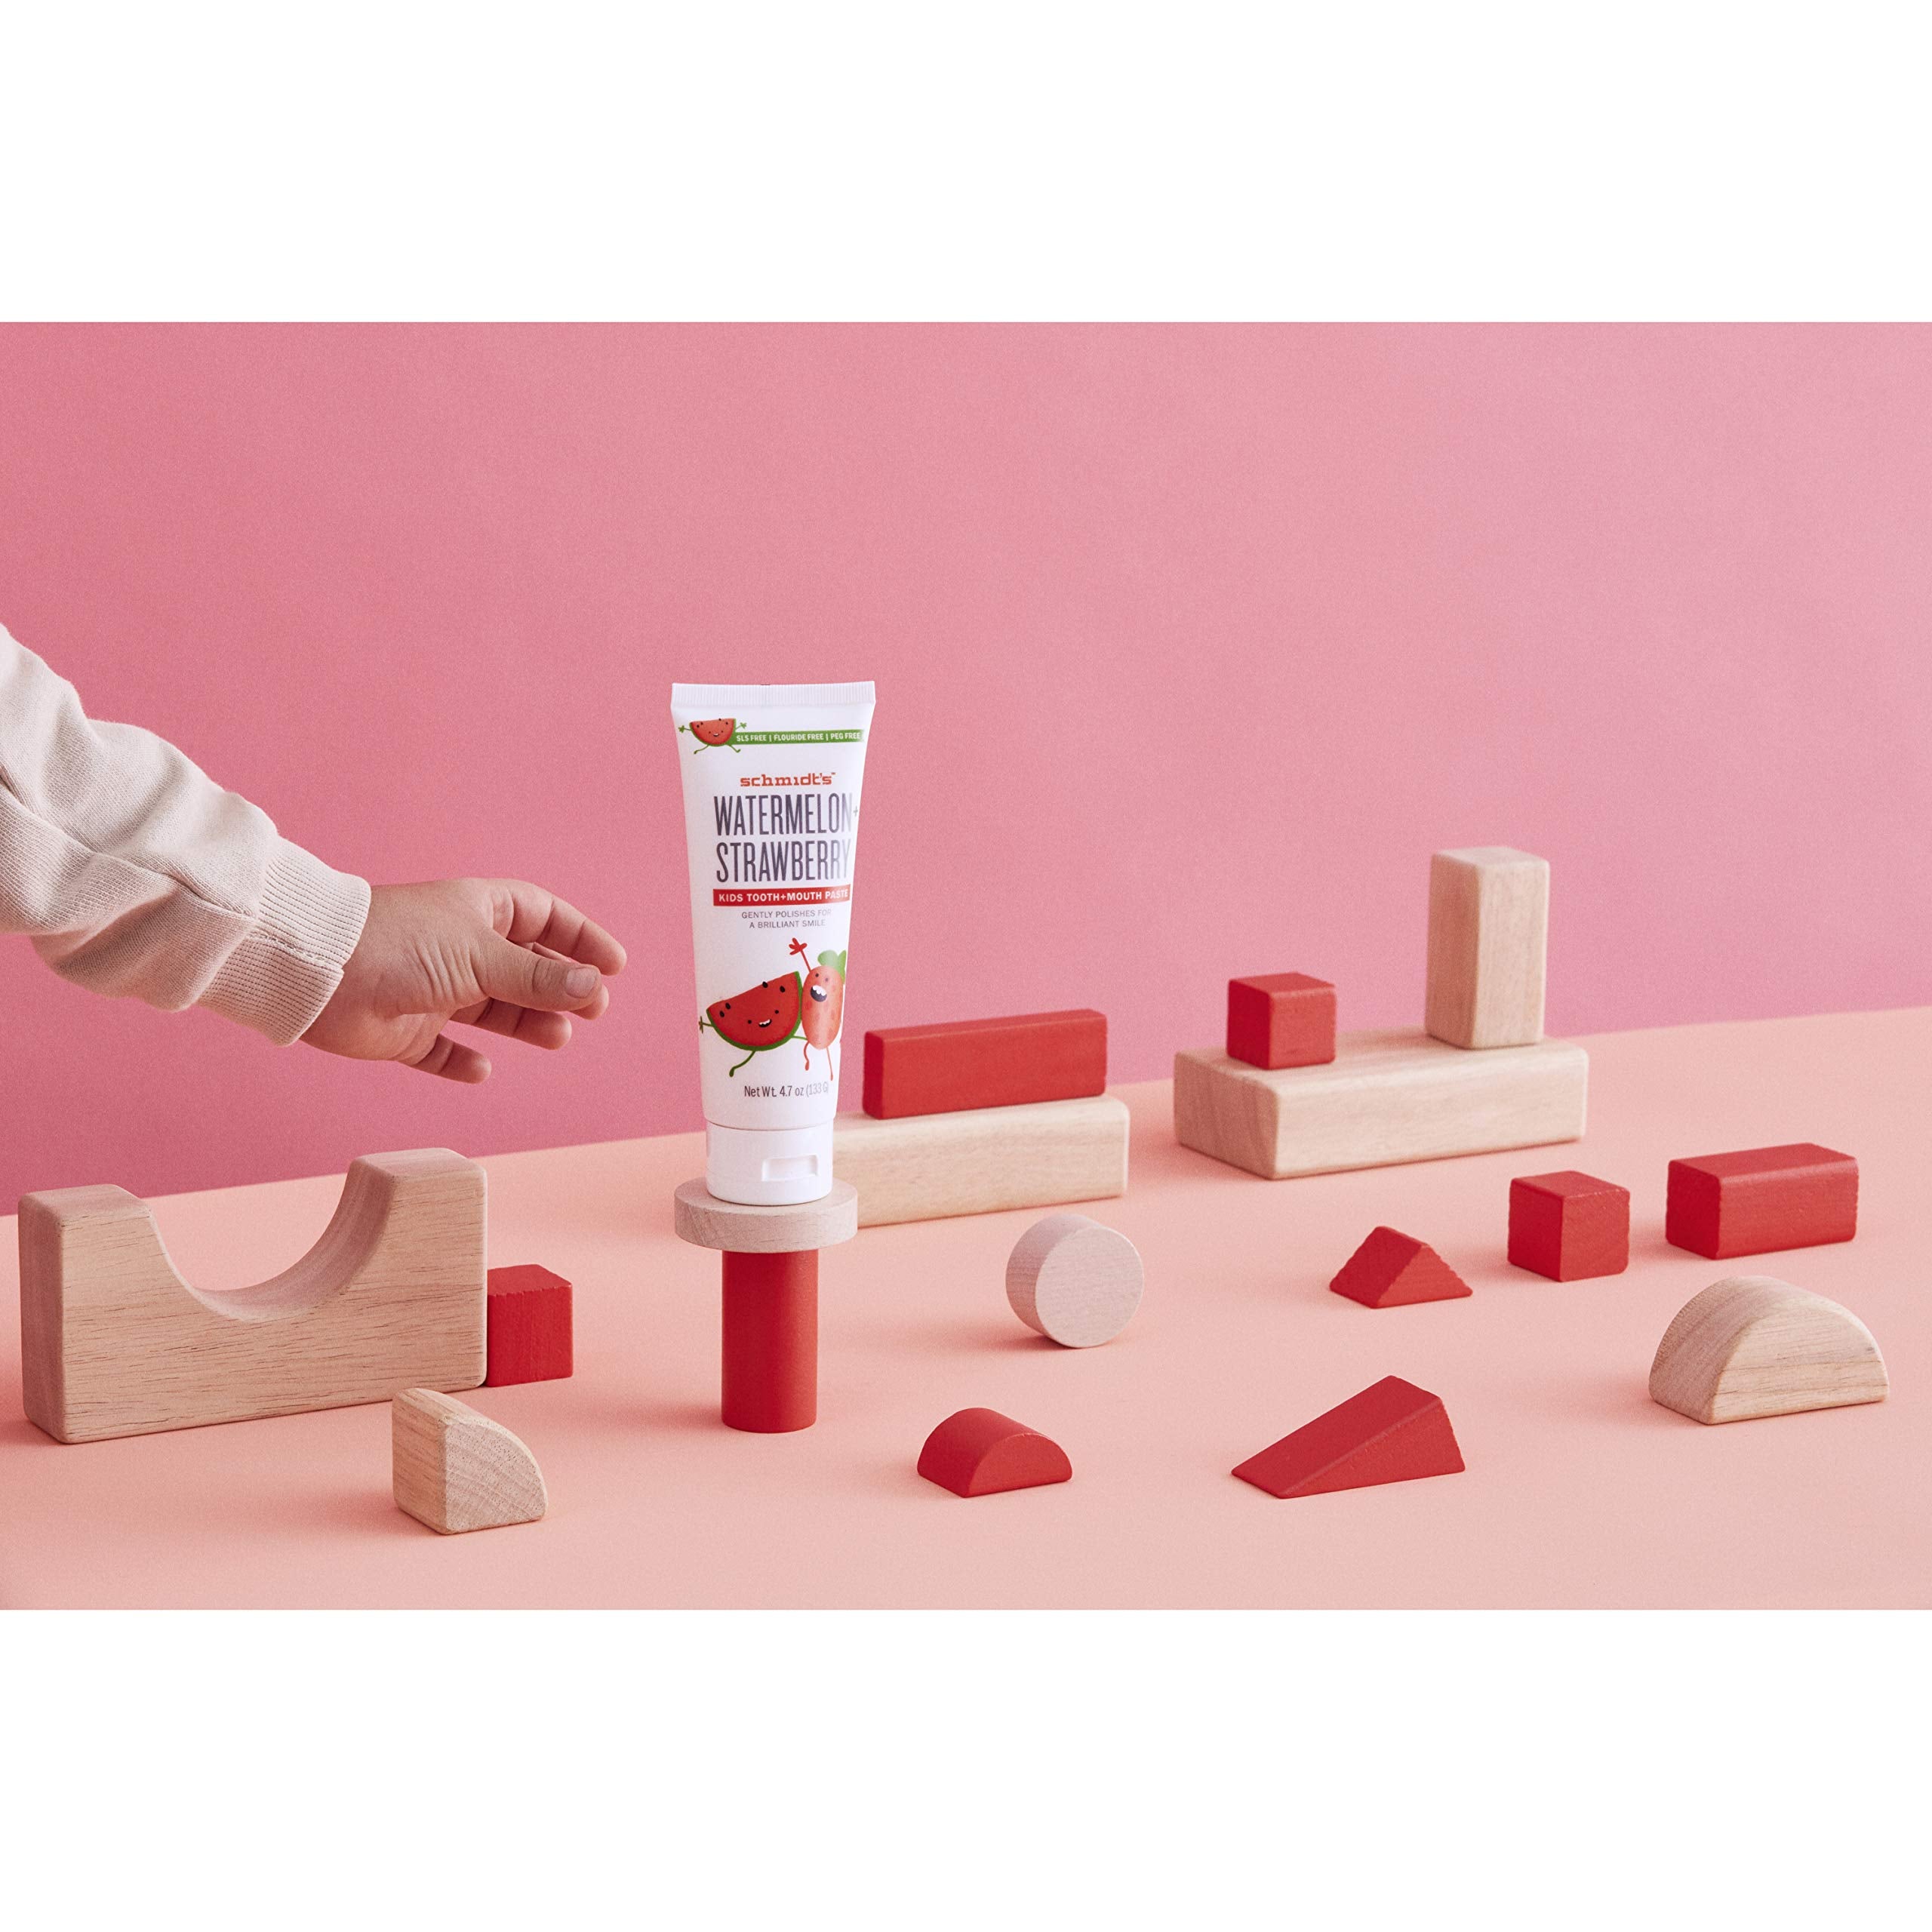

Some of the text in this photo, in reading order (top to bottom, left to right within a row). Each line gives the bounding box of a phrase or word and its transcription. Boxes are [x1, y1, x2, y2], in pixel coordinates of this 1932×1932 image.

[774, 733, 807, 741] FLOURIDE
[716, 838, 851, 883] STRAWBERRY
[718, 894, 743, 903] KIDS
[825, 889, 848, 900] PASTE
[741, 908, 832, 919] GENTLY POLISHES FOR
[758, 920, 799, 928] BRILLIANT
[802, 918, 826, 928] SMILE
[744, 1085, 761, 1097] Net
[780, 1085, 792, 1097] 4.7
[795, 1087, 804, 1097] oz
